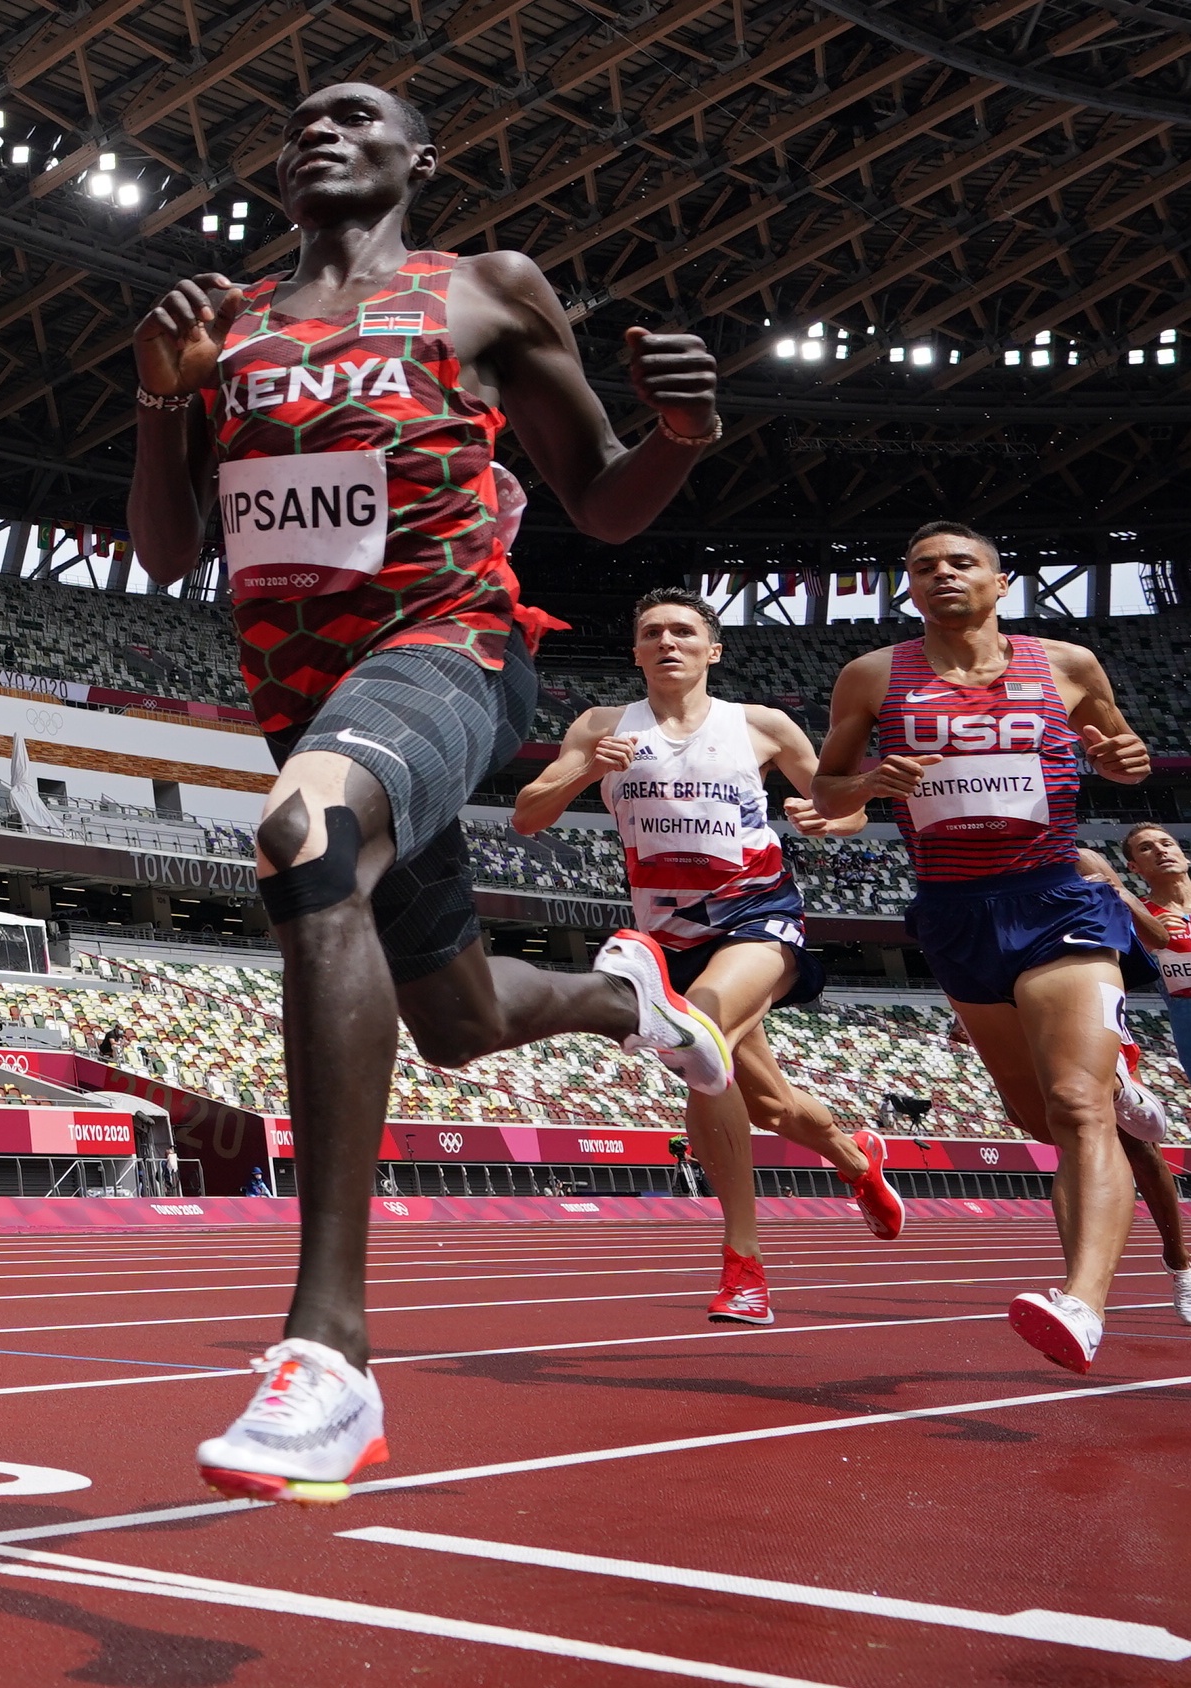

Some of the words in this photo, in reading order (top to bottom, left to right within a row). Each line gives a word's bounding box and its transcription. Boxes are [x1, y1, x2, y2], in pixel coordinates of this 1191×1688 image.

[221, 357, 412, 421] KENYA
[221, 484, 377, 535] KIPSANG
[244, 577, 266, 588] TOKYO
[266, 575, 288, 586] 2020
[29, 675, 68, 699] 2020
[904, 712, 1046, 752] USA
[623, 781, 668, 800] GREAT
[673, 782, 740, 806] BRITAIN
[640, 817, 737, 838] WIGHTMAN
[967, 822, 985, 830] 2020
[129, 852, 203, 887] TOKYO
[207, 860, 258, 893] 2020
[541, 897, 604, 927] TOKYO
[68, 1124, 103, 1141] TOKYO
[104, 1125, 130, 1142] 2020
[578, 1138, 605, 1153] TOKYO
[605, 1139, 624, 1154] 2020
[150, 1204, 179, 1215] TOKYO
[179, 1204, 203, 1215] 2020
[561, 1203, 582, 1212] TOKYO
[582, 1203, 599, 1212] 2020
